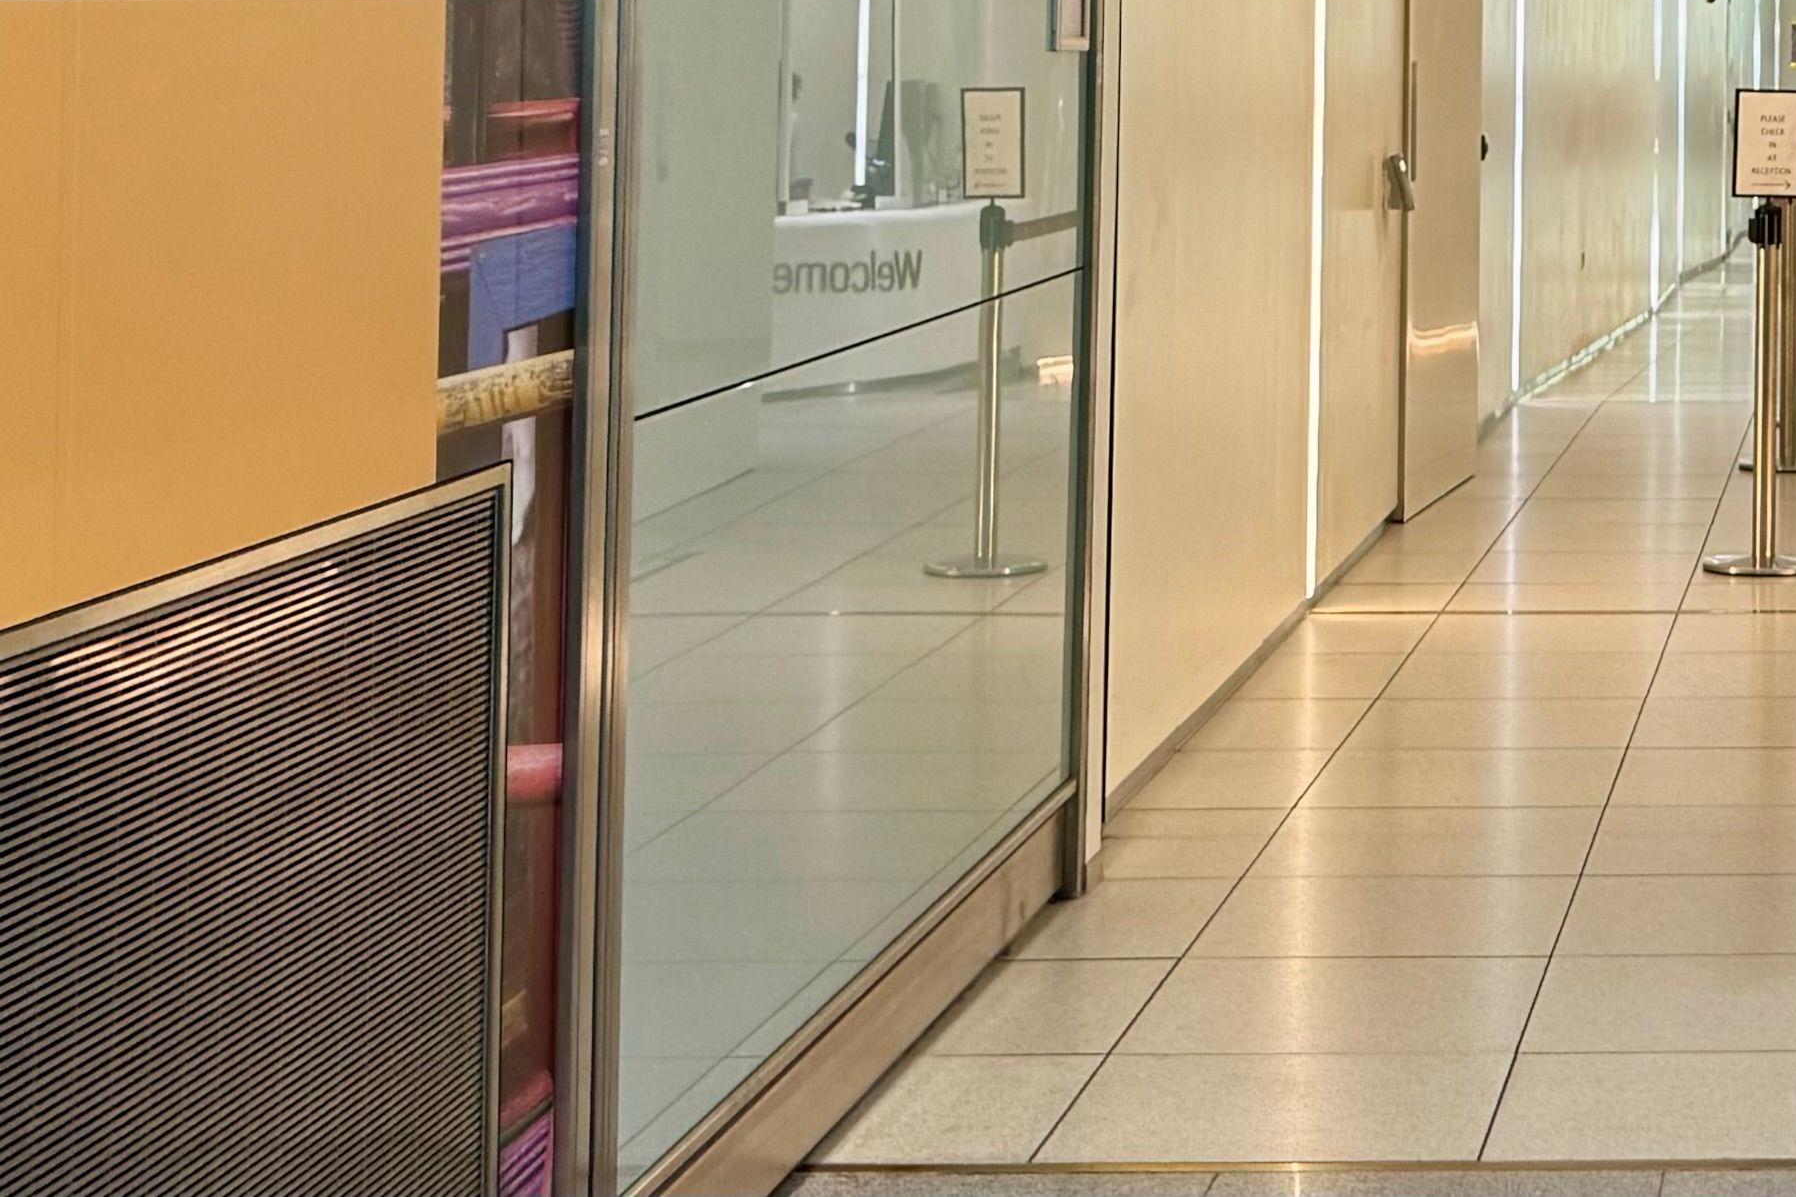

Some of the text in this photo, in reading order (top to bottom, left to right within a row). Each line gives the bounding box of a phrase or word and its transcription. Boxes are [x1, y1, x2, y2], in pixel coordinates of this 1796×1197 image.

[1760, 115, 1785, 123] PLEASE
[1760, 127, 1784, 136] CHECK
[1768, 141, 1777, 149] IN
[1767, 154, 1777, 162] AT
[1751, 167, 1791, 175] RECEPTION
